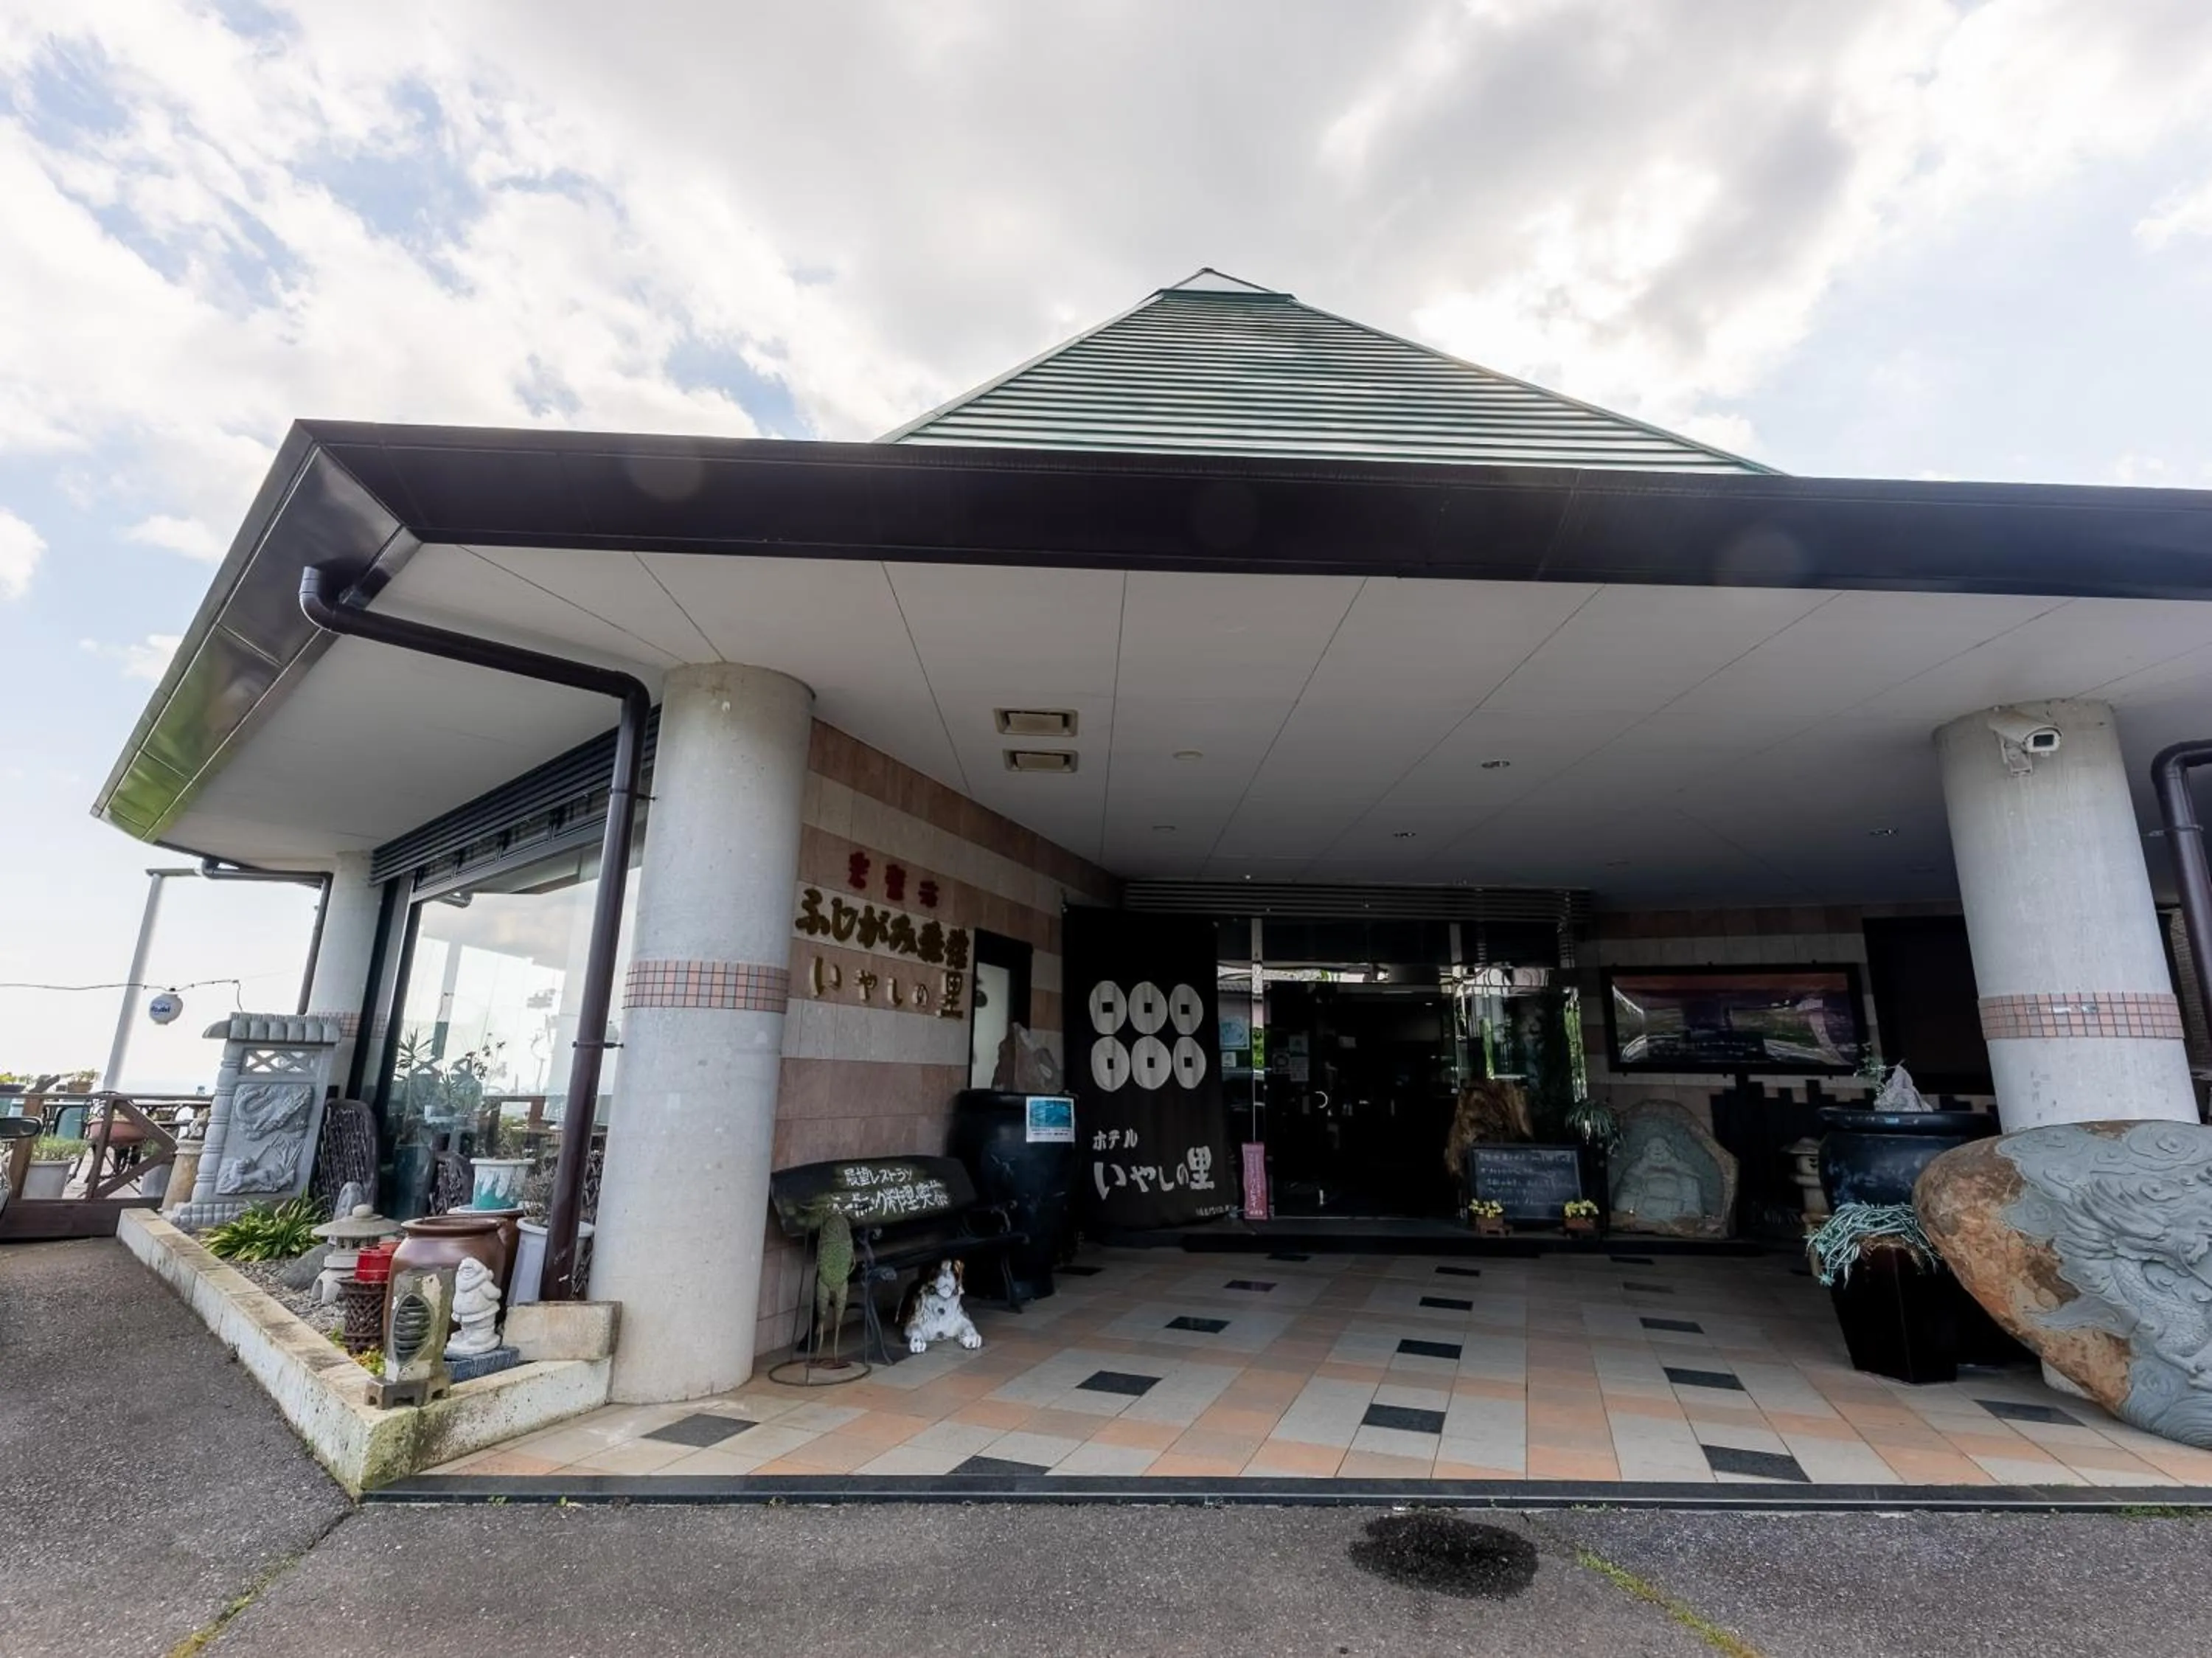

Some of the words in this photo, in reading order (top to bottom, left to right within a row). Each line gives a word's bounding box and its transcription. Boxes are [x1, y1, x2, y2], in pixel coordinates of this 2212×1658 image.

[810, 957, 964, 1019] いやしの里
[1093, 1128, 1138, 1151] ホテル
[1093, 1145, 1216, 1201] いやしの里
